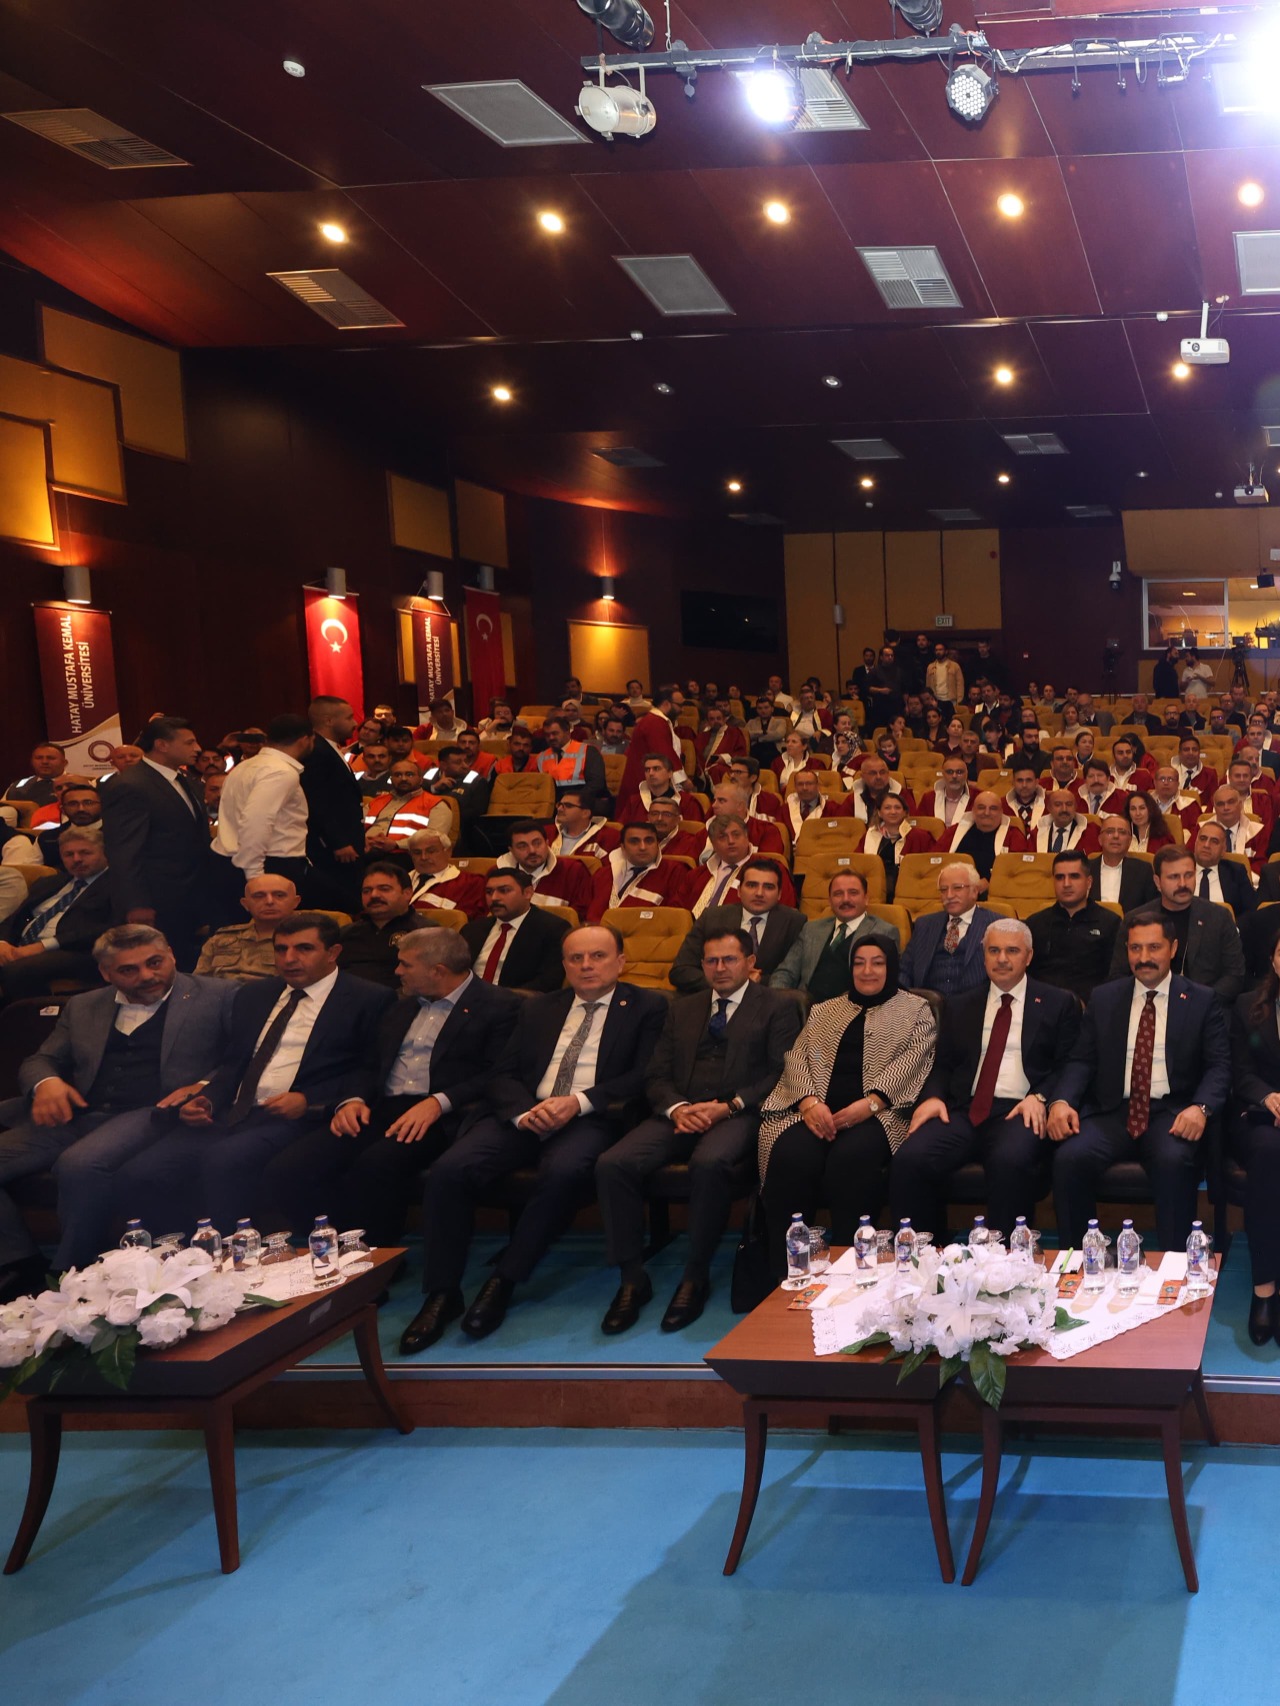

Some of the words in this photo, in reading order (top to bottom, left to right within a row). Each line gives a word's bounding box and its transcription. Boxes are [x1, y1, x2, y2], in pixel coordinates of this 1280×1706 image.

[60, 615, 74, 650] KEMAL
[937, 617, 950, 625] EXIT
[64, 652, 78, 700] MUSTAFA
[76, 641, 95, 709] ÜNİVERSİTESİ
[426, 643, 434, 678] MUSTAFA
[69, 702, 82, 734] HATAY
